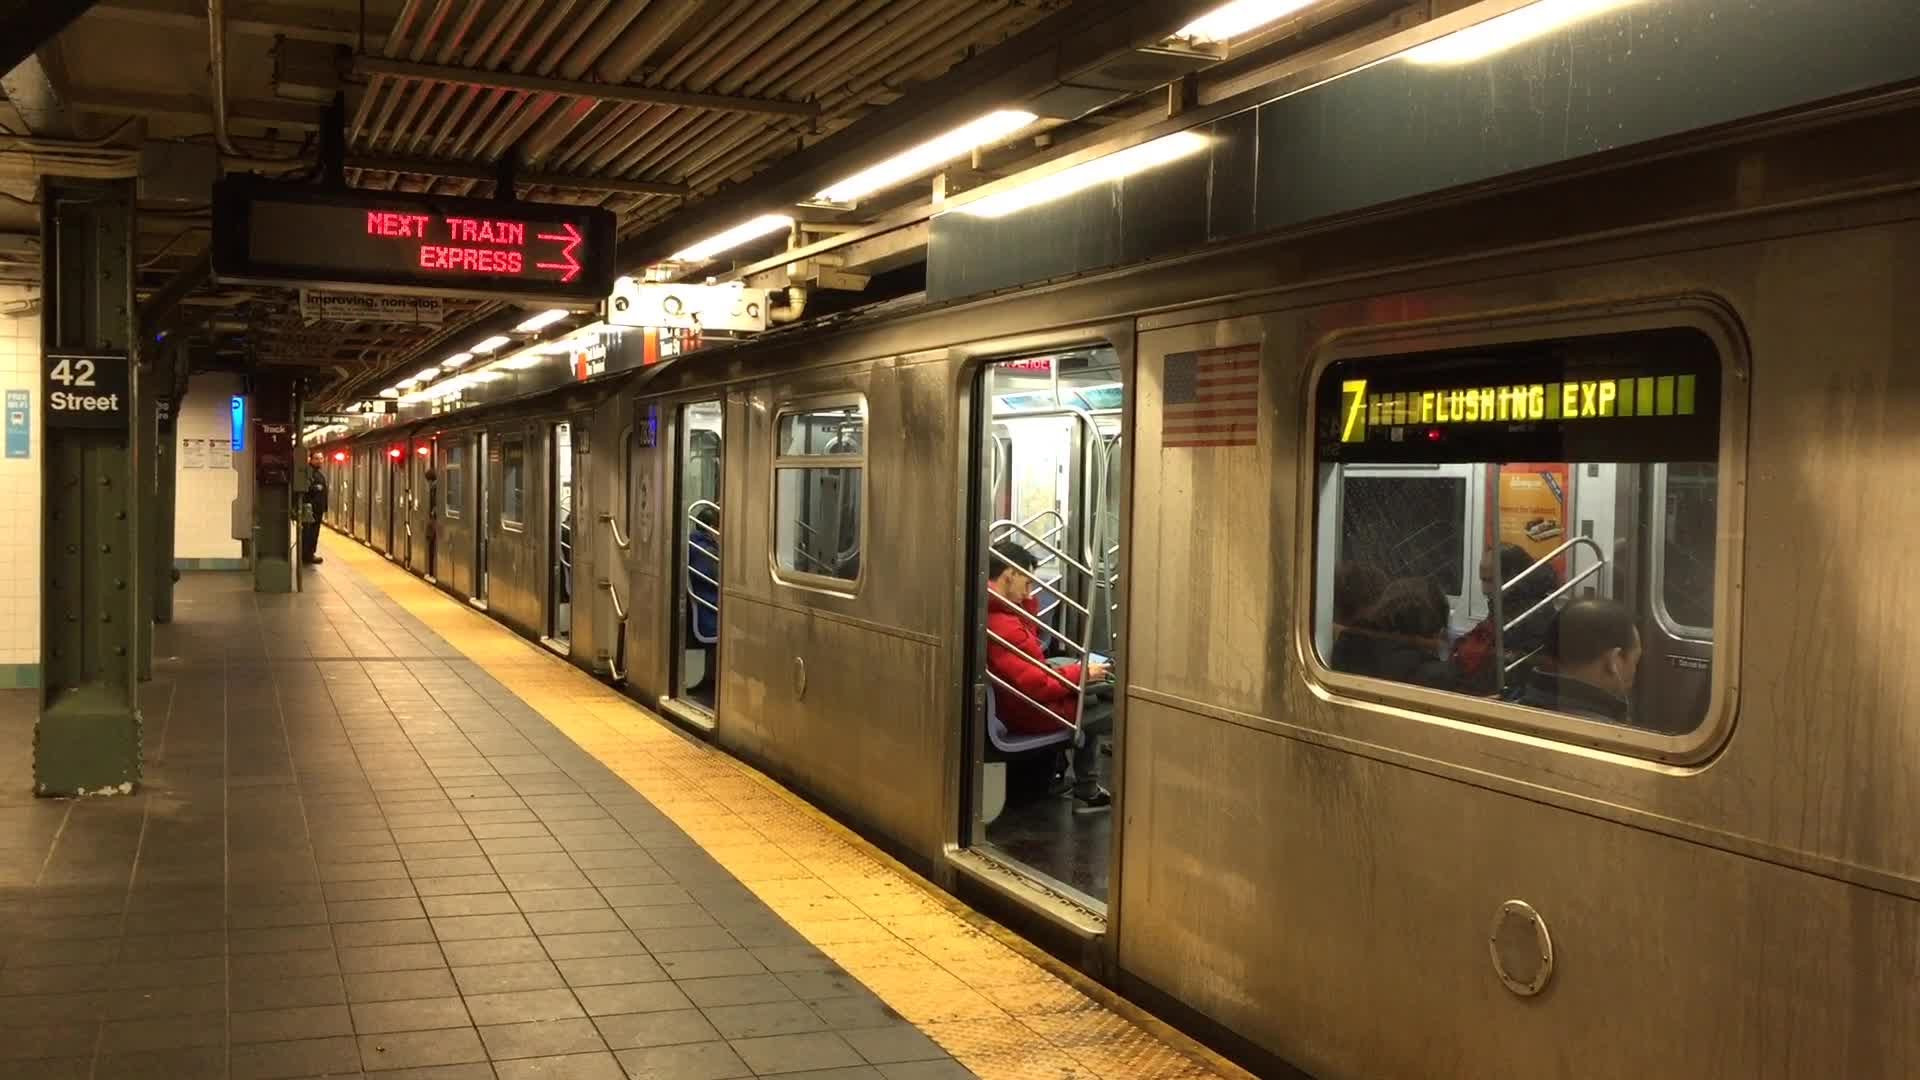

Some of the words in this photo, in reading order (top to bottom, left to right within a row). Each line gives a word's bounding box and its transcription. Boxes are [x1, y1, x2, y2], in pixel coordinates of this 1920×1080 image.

[367, 211, 429, 238] NEXT
[446, 217, 525, 246] TRAIN
[419, 246, 523, 274] EXPRESS
[306, 294, 379, 308] Improving,
[50, 359, 96, 387] 42
[50, 392, 119, 411] Street
[1340, 378, 1367, 443] 7
[1421, 384, 1544, 424] FLUSHING
[1562, 379, 1616, 418] EXP
[261, 424, 286, 433] Track
